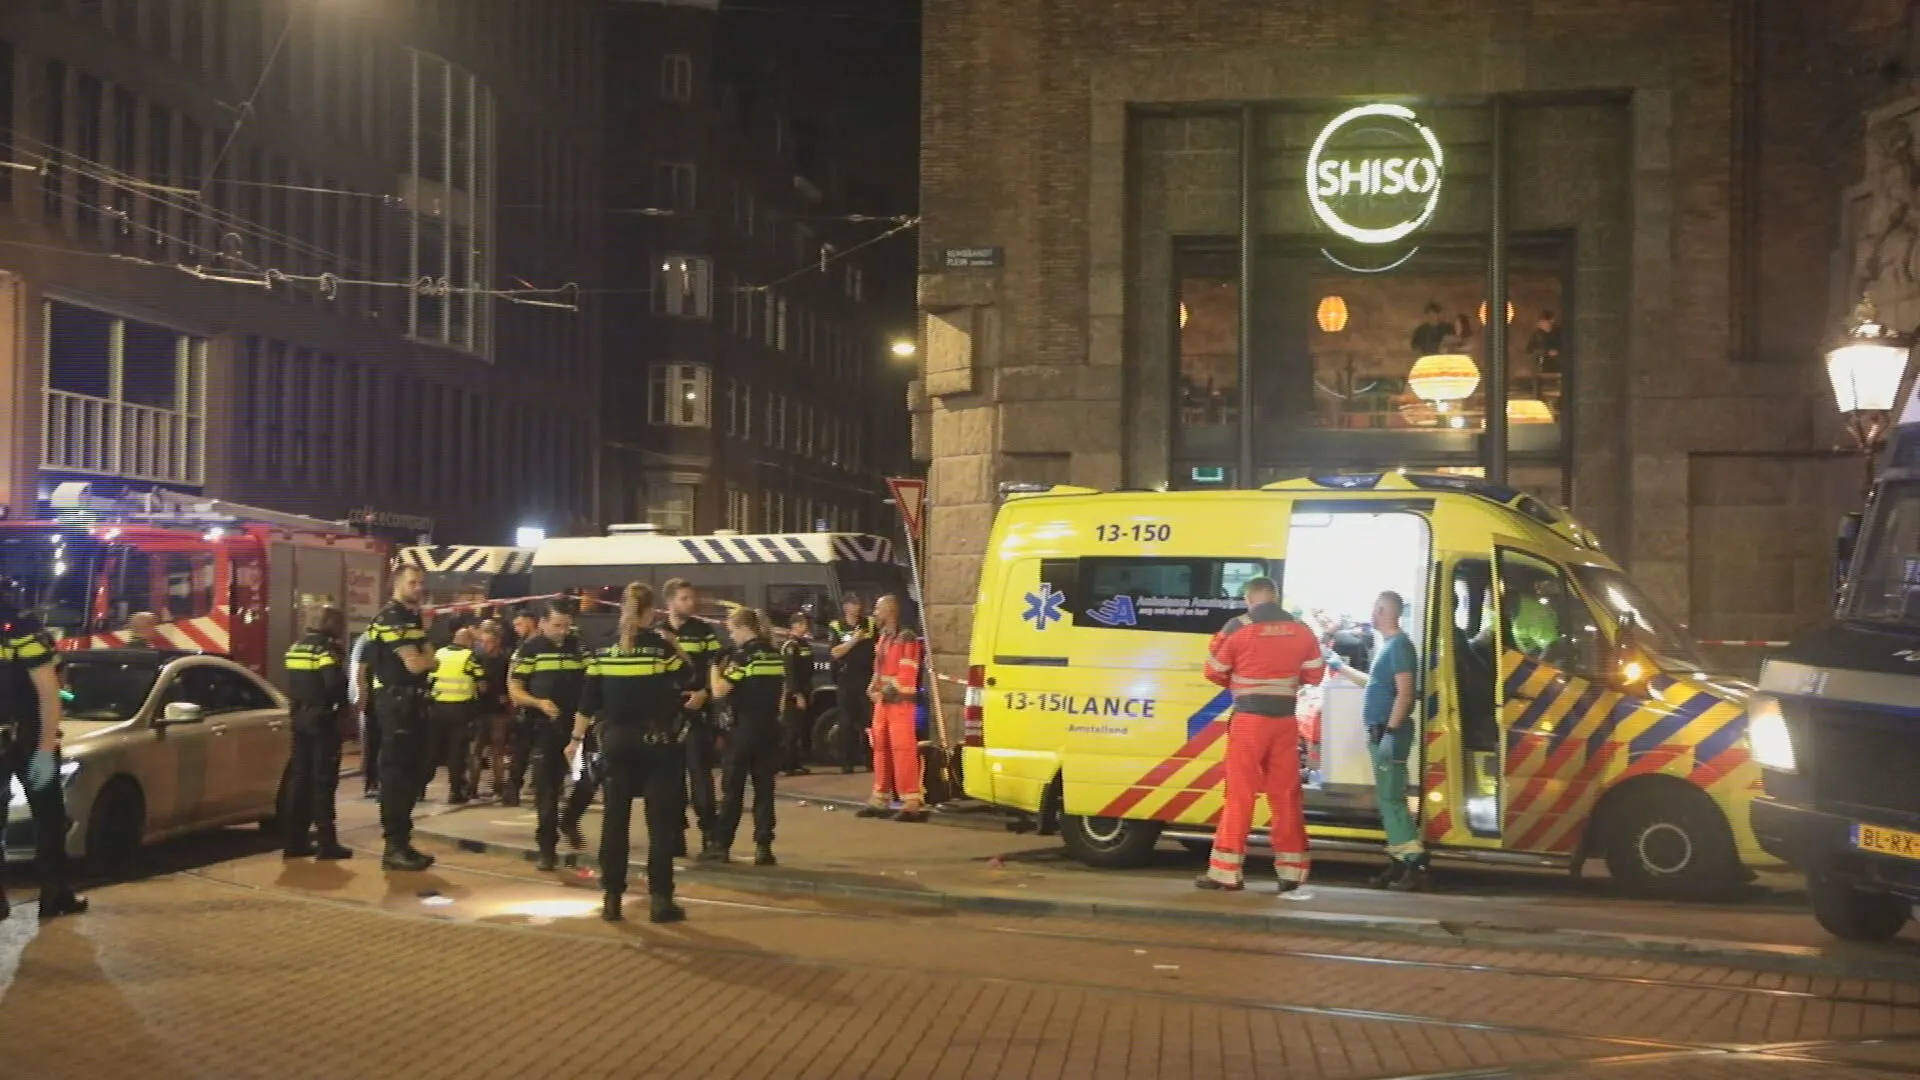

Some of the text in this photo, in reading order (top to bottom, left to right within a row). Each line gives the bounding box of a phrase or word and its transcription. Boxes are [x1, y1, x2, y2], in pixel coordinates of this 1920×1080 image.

[1318, 157, 1437, 196] SHISO
[1096, 524, 1171, 542] 13-150
[1067, 696, 1156, 718] LANCE
